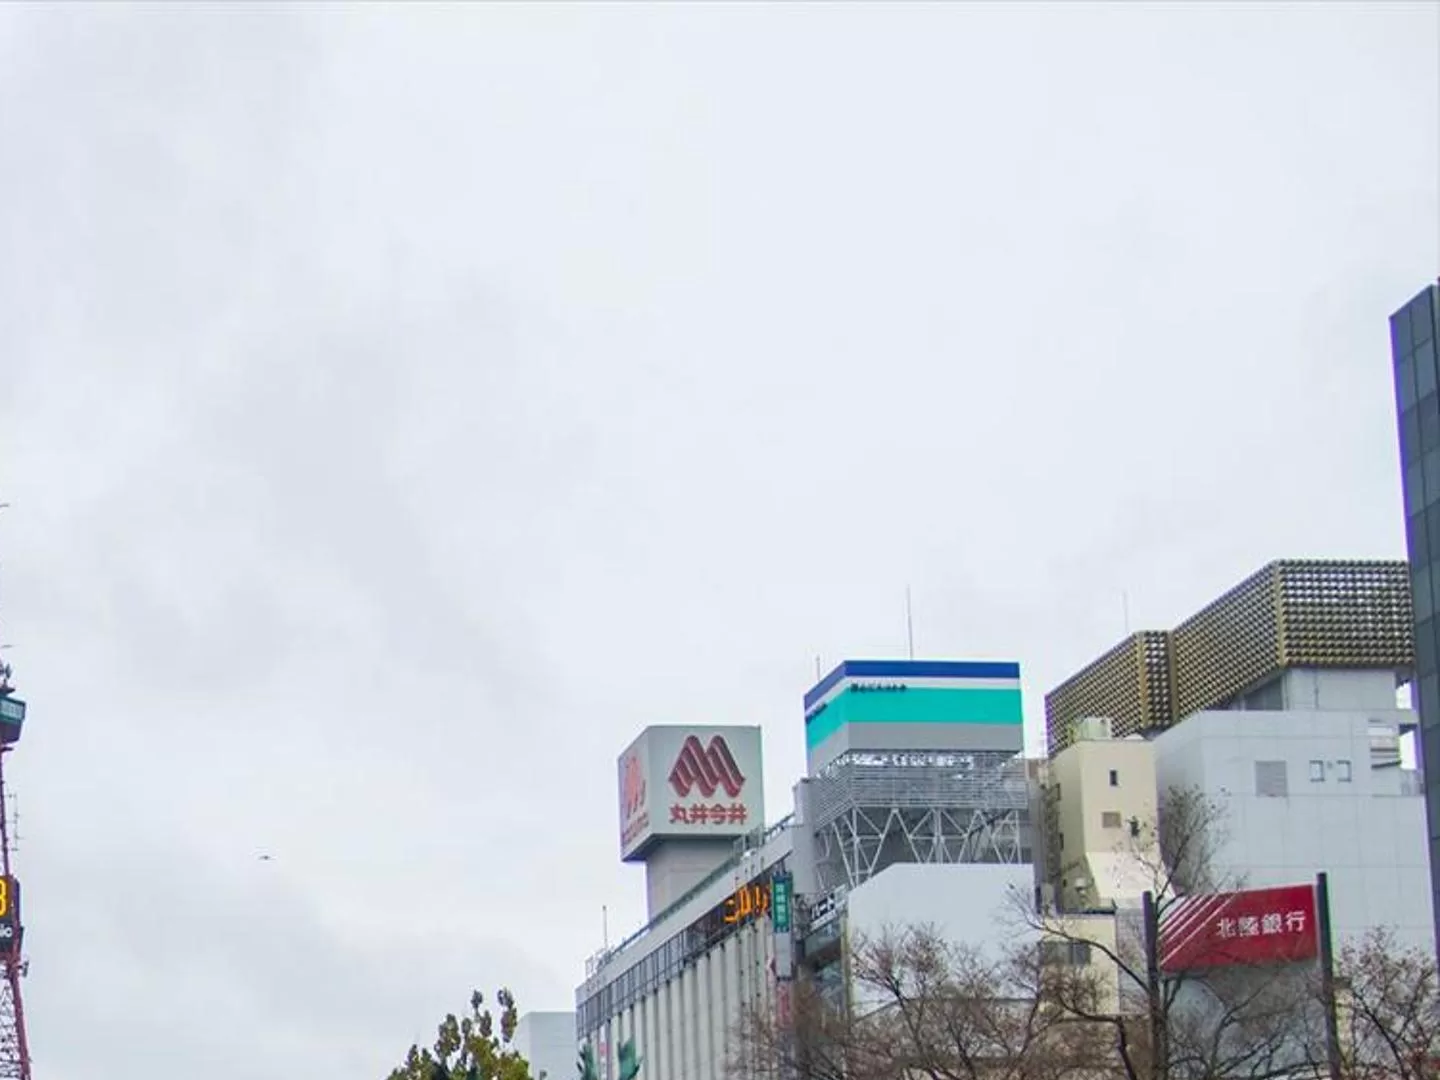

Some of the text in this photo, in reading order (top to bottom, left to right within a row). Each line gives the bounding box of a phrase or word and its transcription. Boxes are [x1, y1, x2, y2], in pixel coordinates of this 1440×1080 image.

[668, 803, 747, 826] 丸井今井
[1216, 910, 1307, 938] 北陸銀行
